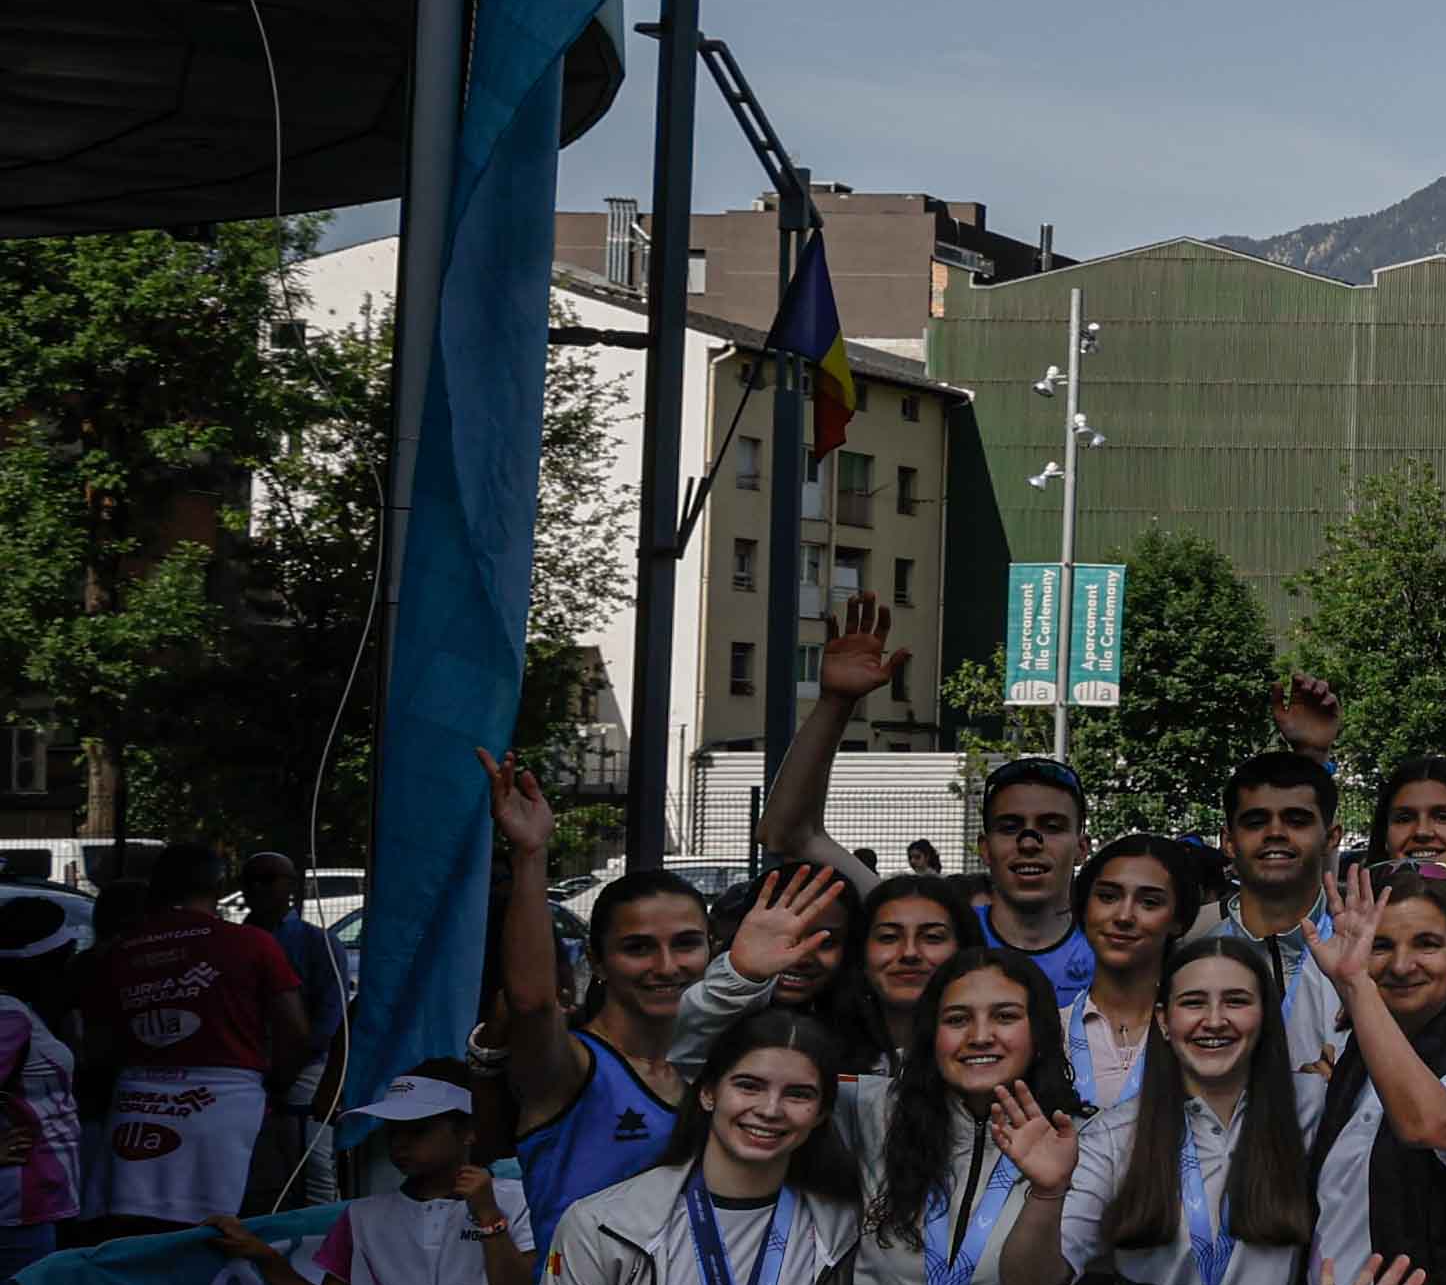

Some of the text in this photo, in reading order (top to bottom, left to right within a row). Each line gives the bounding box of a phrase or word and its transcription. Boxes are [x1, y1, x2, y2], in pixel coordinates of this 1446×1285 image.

[1018, 583, 1035, 670] Aparcament
[1034, 568, 1057, 671] illa Carlemany
[1081, 583, 1098, 671] Aparcament
[1097, 570, 1120, 672] illa Carlemany
